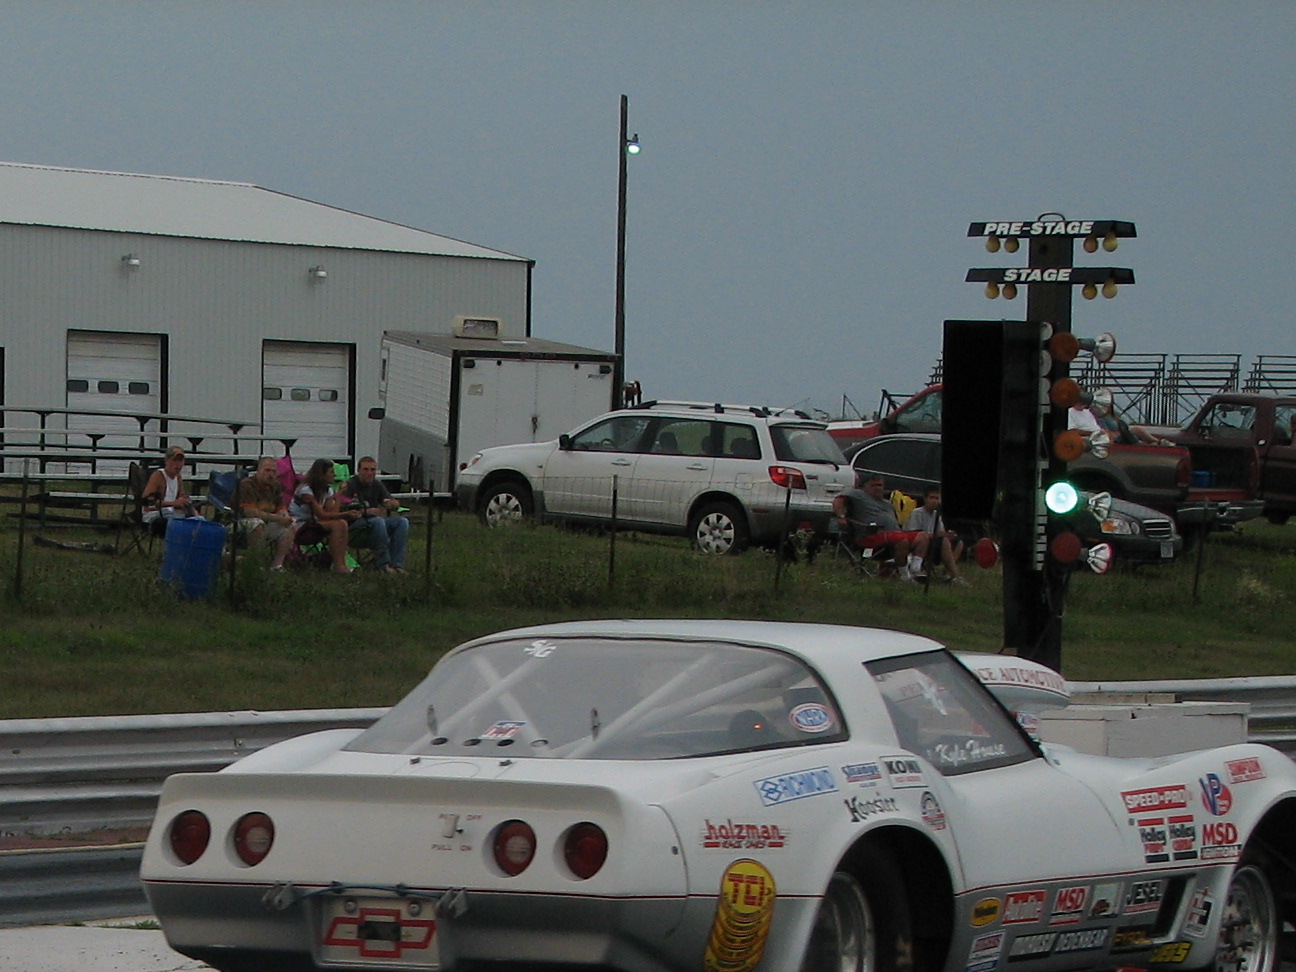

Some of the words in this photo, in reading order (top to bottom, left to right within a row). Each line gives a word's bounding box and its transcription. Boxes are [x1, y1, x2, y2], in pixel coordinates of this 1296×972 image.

[983, 221, 1094, 236] PRE-STAGE
[1004, 268, 1072, 282] STAGE
[884, 759, 923, 775] KONI
[844, 792, 900, 822] Hoosier
[1124, 789, 1192, 808] SPEED-PRO
[704, 819, 786, 840] holzman
[1202, 823, 1238, 846] MSD
[1055, 888, 1086, 911] MSD
[1126, 881, 1164, 906] JESEL
